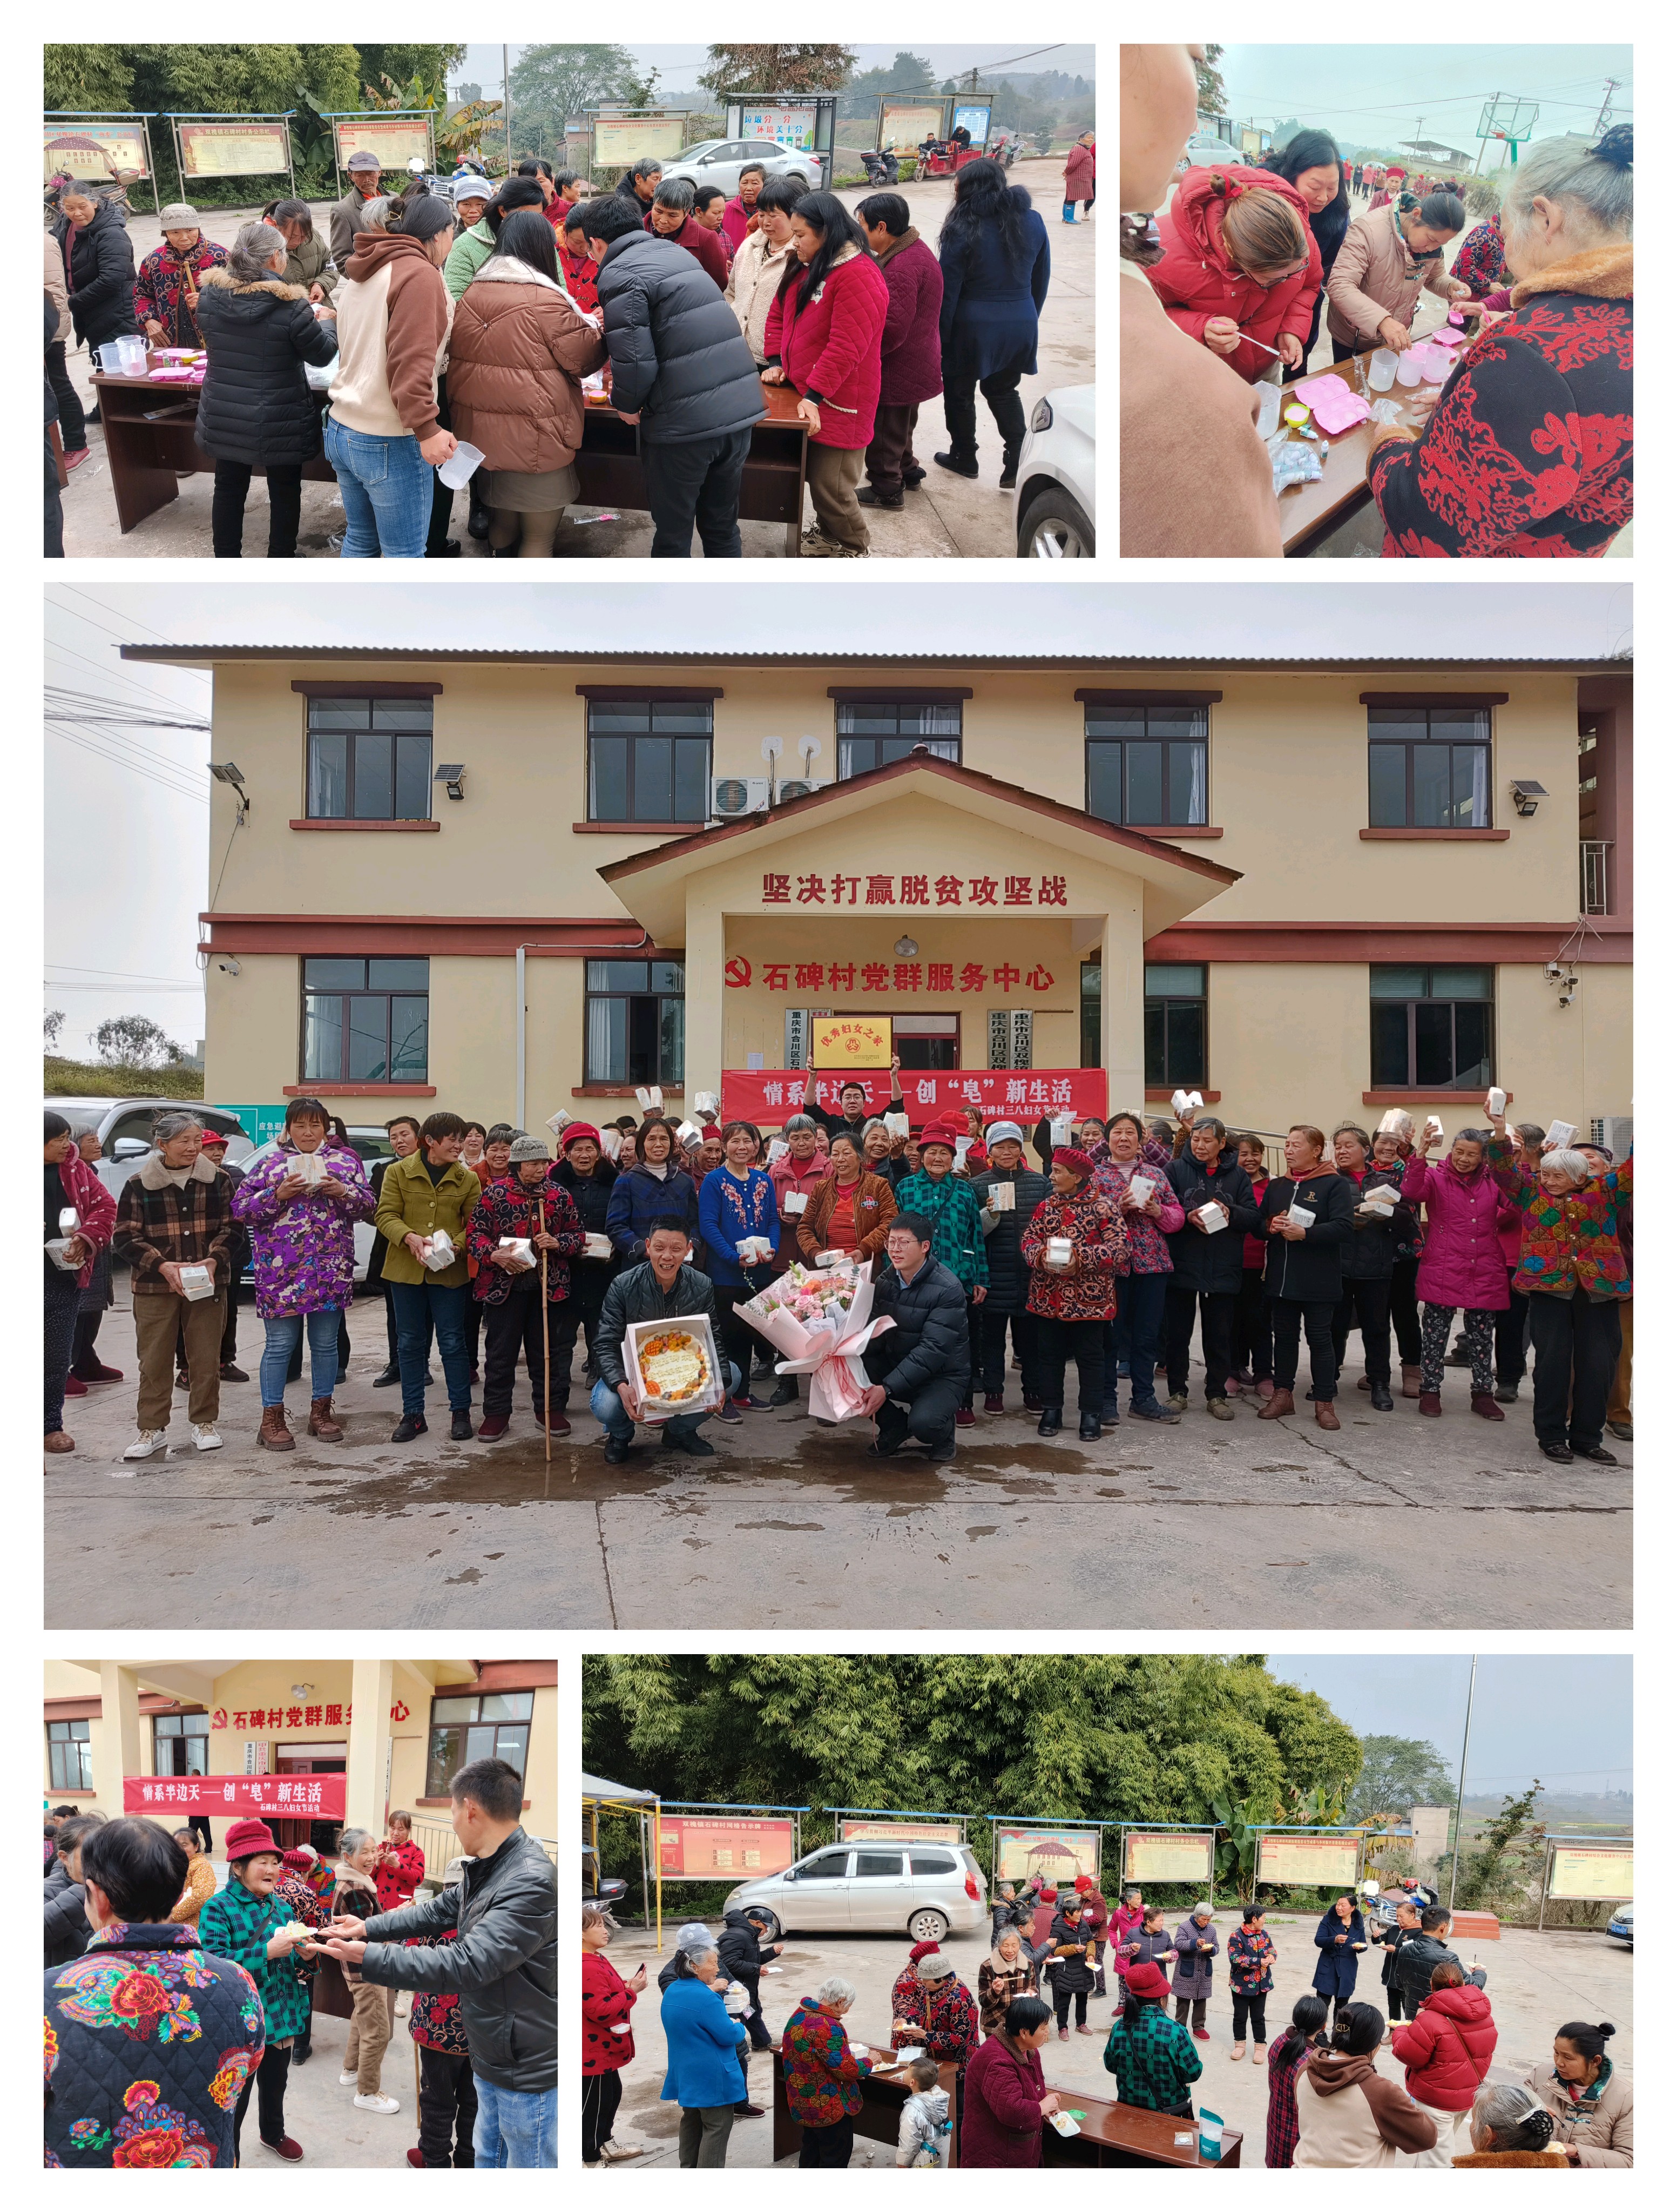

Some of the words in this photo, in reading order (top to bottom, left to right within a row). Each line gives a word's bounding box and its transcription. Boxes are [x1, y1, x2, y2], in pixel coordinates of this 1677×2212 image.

[745, 115, 791, 124] 垃圾分一分
[756, 125, 803, 134] 环境美十分
[762, 873, 1068, 906] 坚决打赢脱贫攻坚战
[762, 962, 1055, 992] 石碑村党群服务中心
[820, 1023, 883, 1047] 优秀妇女之家
[233, 1700, 410, 1730] 石碑村党群服心
[260, 1803, 320, 1812] 石碑村三八妇女节活动
[682, 1820, 761, 1830] 双槐镇石碑村网格告示牌
[860, 1829, 948, 1837] 学习贯彻习近平新时代中国特色社会主义思想
